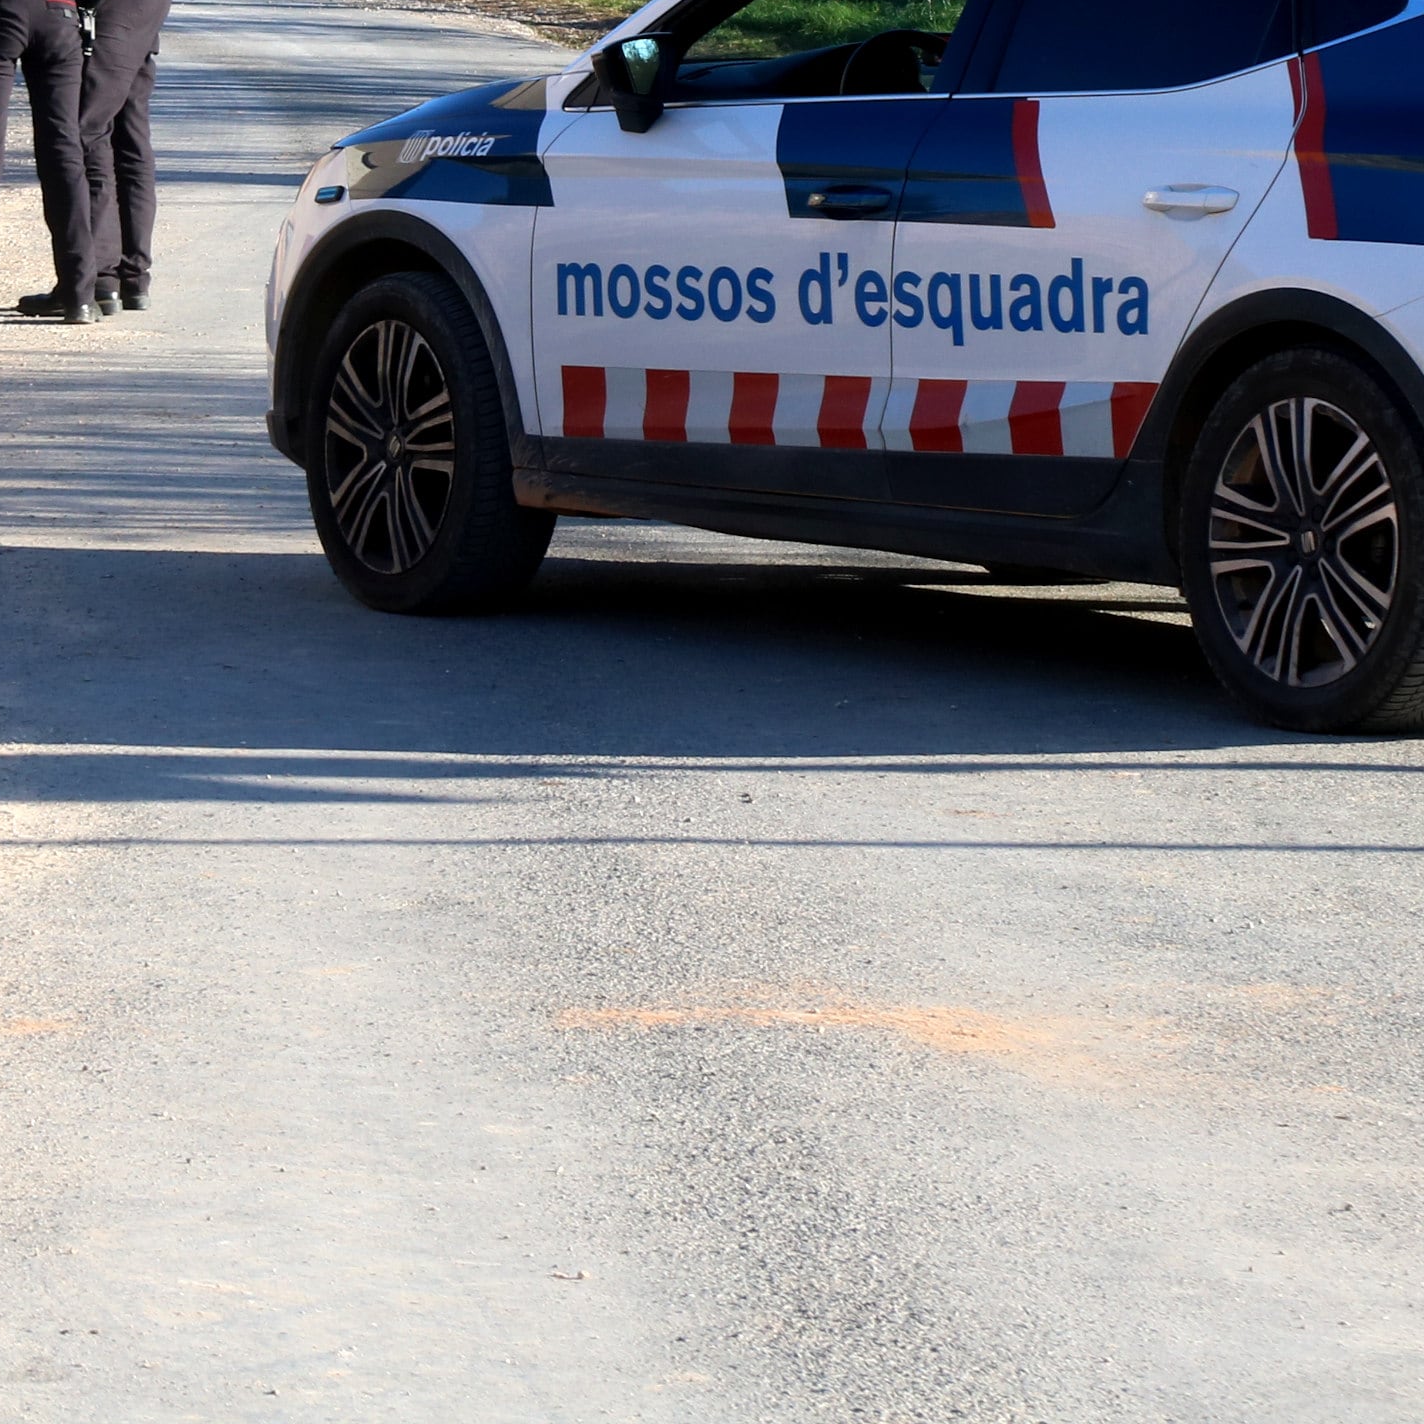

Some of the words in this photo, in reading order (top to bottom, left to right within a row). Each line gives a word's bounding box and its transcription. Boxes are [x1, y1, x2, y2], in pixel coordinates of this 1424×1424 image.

[419, 131, 496, 162] policia
[556, 262, 776, 324] mossos
[798, 252, 1149, 346] d'esquadra
